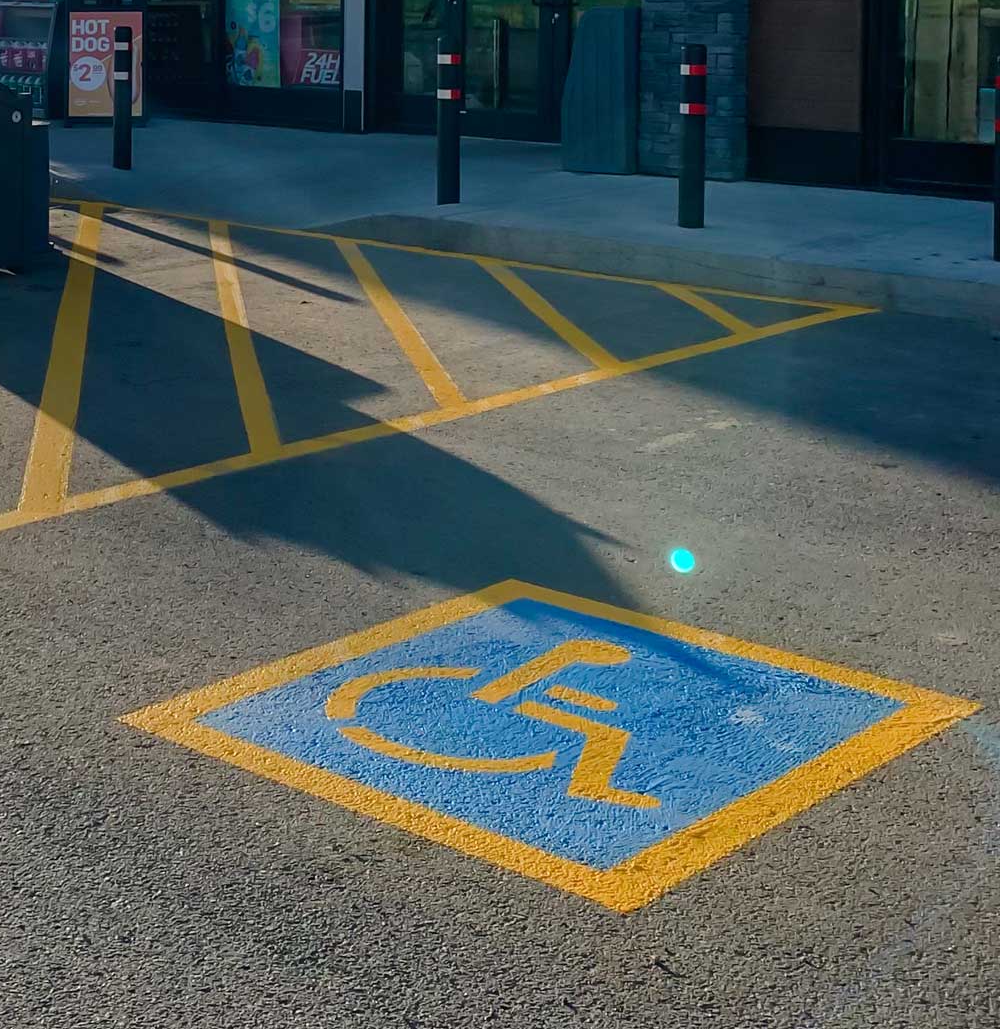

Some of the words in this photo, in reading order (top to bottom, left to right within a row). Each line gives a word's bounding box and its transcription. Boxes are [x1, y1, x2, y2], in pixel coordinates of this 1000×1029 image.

[71, 19, 110, 35] HOT
[71, 37, 111, 53] DOG
[305, 51, 341, 69] 24H
[300, 67, 340, 85] FUEL
